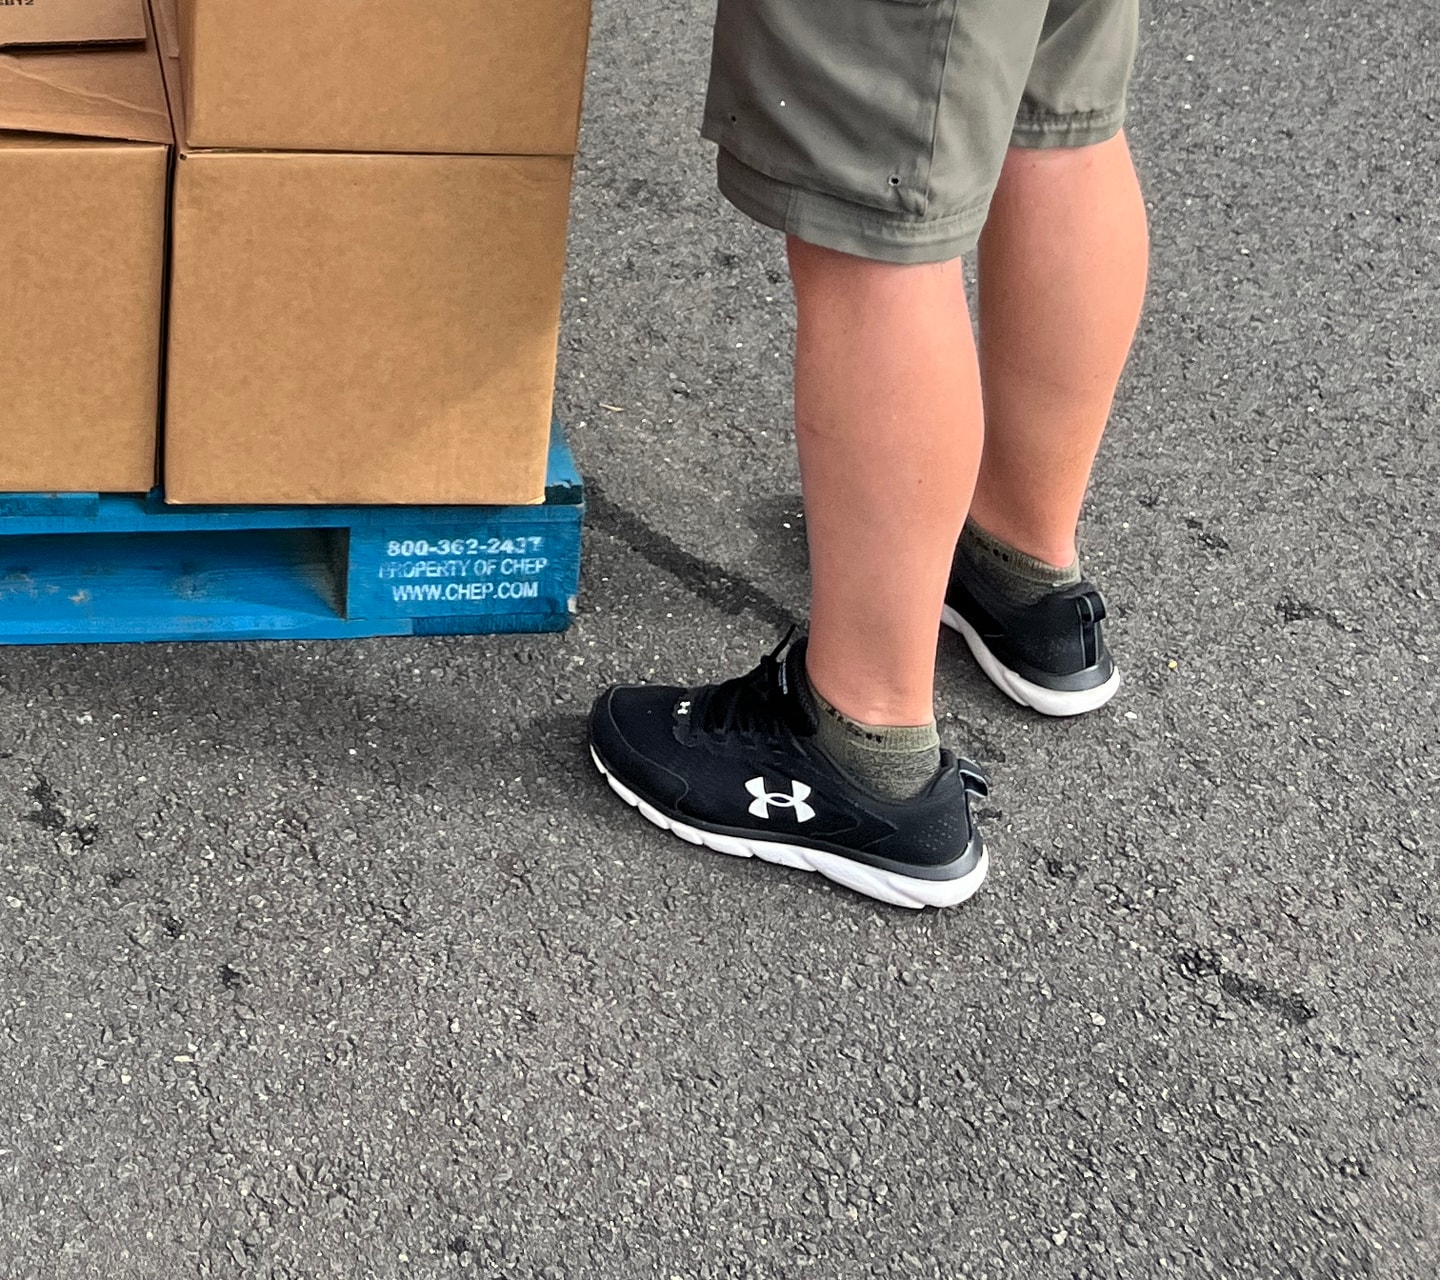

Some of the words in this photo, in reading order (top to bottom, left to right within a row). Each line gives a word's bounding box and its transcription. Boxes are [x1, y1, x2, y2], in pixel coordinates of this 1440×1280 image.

[379, 560, 471, 578] PROPERTY
[473, 559, 498, 576] OF
[500, 557, 548, 575] CHEP
[392, 582, 538, 601] WWW.CHEP.COM
